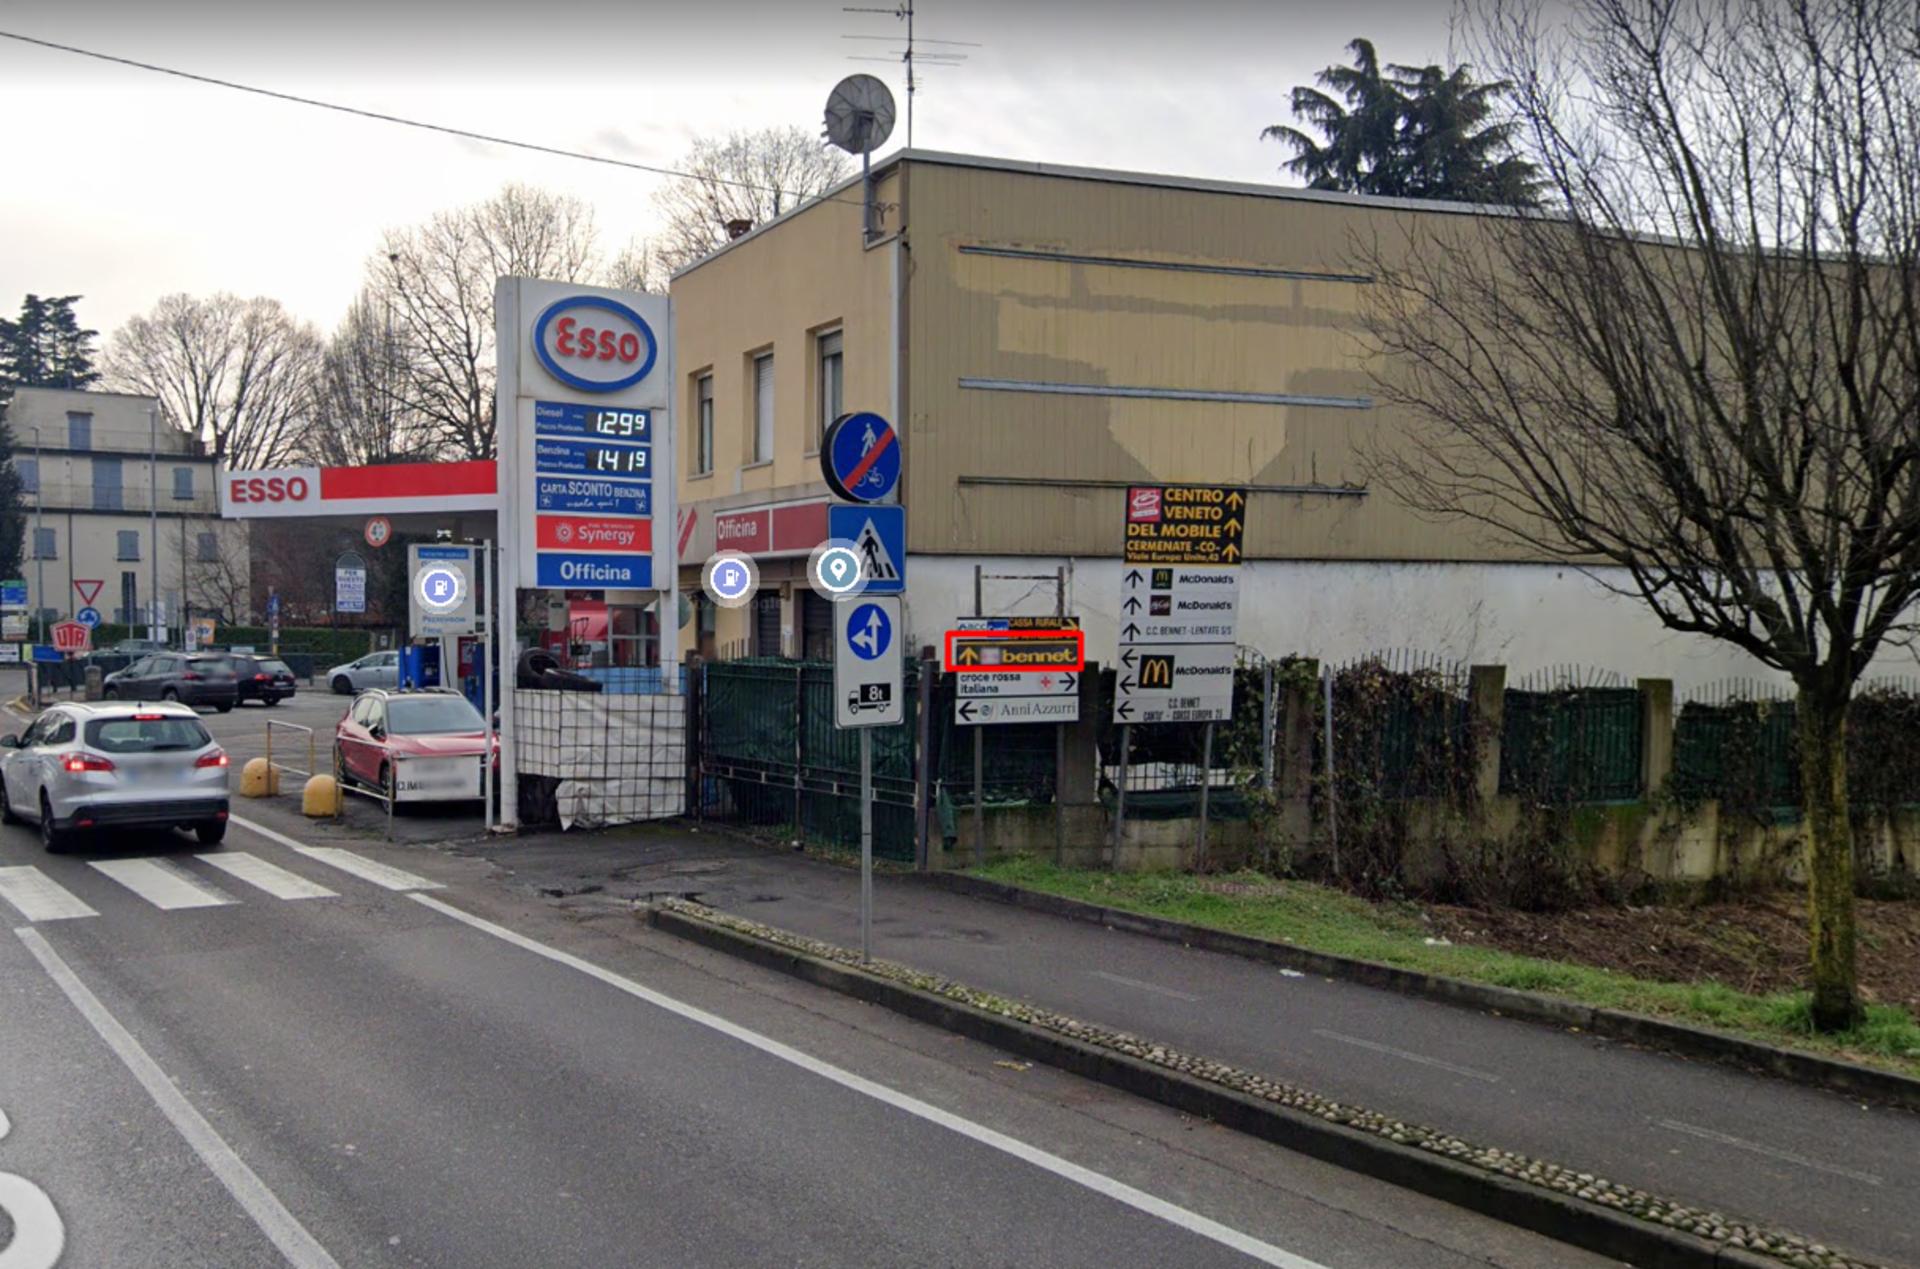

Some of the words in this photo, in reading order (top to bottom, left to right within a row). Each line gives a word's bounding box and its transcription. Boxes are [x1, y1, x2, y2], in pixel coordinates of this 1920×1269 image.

[536, 407, 564, 418] Diesel
[537, 445, 570, 456] Benzina
[230, 477, 308, 503] ESSO
[541, 483, 567, 494] CARTA
[568, 481, 613, 497] SCONTO
[614, 487, 646, 499] BENZINA
[1164, 488, 1224, 502] CENTRO
[1163, 506, 1223, 520] VENETO
[579, 526, 635, 545] Synergy
[717, 518, 757, 541] Officina
[1128, 524, 1157, 537] DEL
[1161, 524, 1222, 538] MOBILE
[1127, 540, 1192, 551] CERMENATE
[560, 561, 631, 581] Officina
[1179, 575, 1234, 585] McDonald's
[1177, 600, 1233, 610] McDonald's
[1160, 626, 1187, 636] BENNET
[1002, 648, 1077, 663] bennet
[960, 673, 989, 682] croce
[992, 672, 1021, 681] rossa
[1175, 666, 1231, 676] McDonald's
[868, 685, 883, 702] 8t
[960, 683, 999, 694] italiana
[1000, 704, 1031, 716] Anni
[1032, 703, 1076, 715] Azzurri
